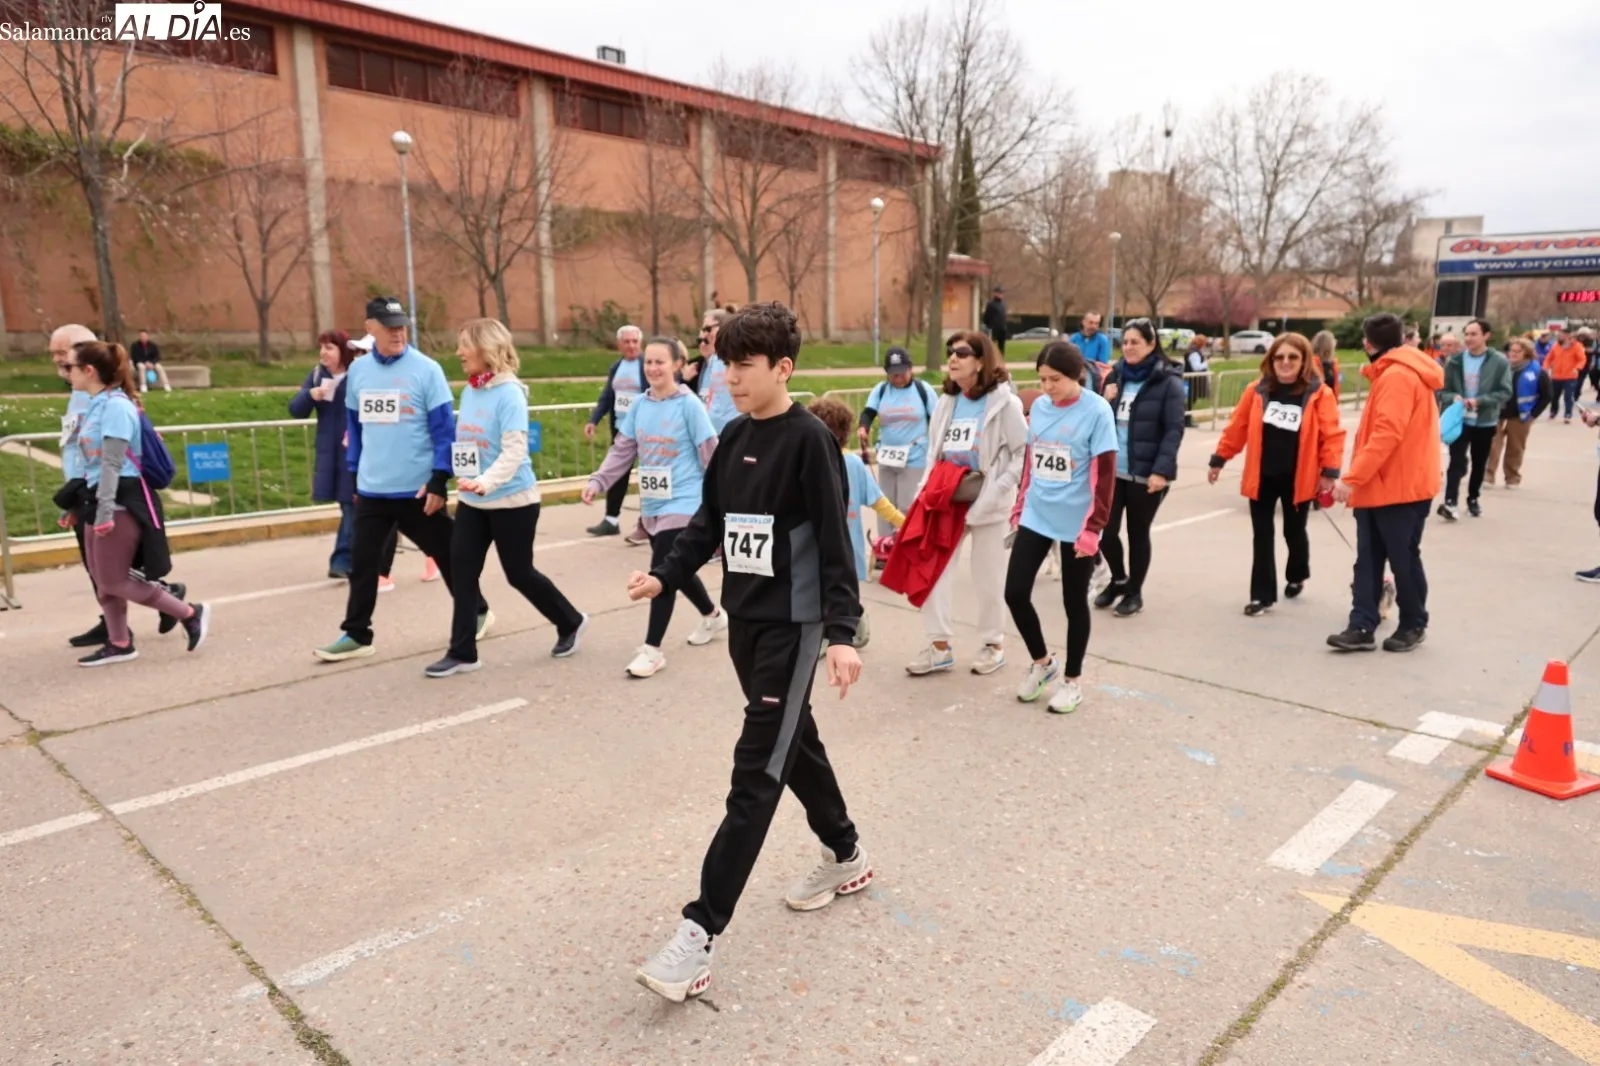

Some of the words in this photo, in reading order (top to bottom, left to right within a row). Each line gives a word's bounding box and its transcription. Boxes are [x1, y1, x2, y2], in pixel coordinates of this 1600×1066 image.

[1474, 257, 1600, 270] www.orycron
[363, 399, 396, 413] 585
[1269, 407, 1299, 423] 733
[881, 449, 905, 461] 752
[1035, 453, 1067, 471] 748
[641, 476, 668, 490] 584
[728, 531, 769, 559] 747
